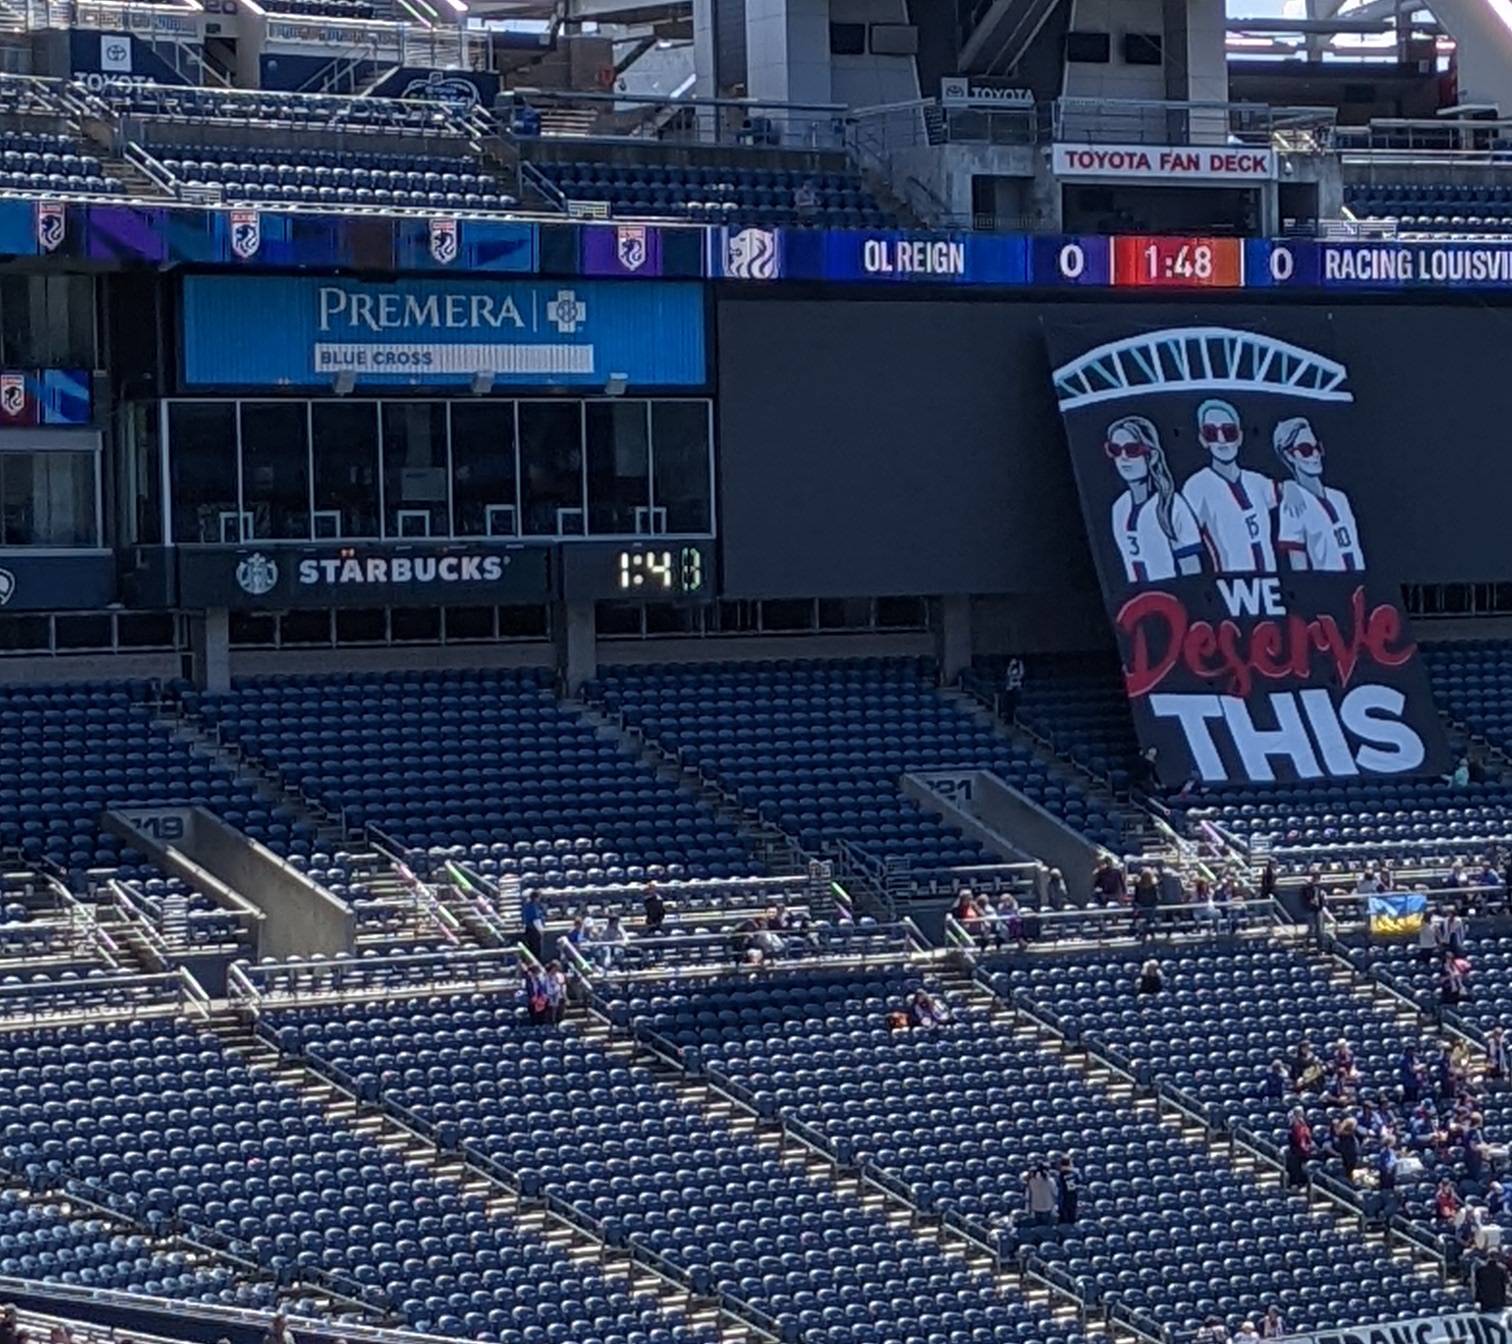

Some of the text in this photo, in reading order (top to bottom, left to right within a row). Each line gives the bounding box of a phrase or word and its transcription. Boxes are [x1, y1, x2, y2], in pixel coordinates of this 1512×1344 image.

[971, 86, 1035, 100] TOYOTA
[1064, 150, 1267, 174] TOYOTA FAN DECK
[864, 239, 965, 274] OL REIGN
[1059, 243, 1085, 278] 0
[1145, 244, 1213, 279] 1:48
[1270, 246, 1294, 280] 0
[1325, 248, 1413, 280] RACING
[319, 287, 526, 331] PREMERA
[320, 350, 434, 366] BLUE CROSS
[1244, 514, 1261, 539] 15
[1333, 526, 1352, 548] 10
[1126, 535, 1141, 556] 3
[300, 555, 503, 584] STARBUCKS
[1215, 576, 1287, 617] WE
[1116, 584, 1417, 699] Deserve
[1148, 684, 1425, 782] THIS
